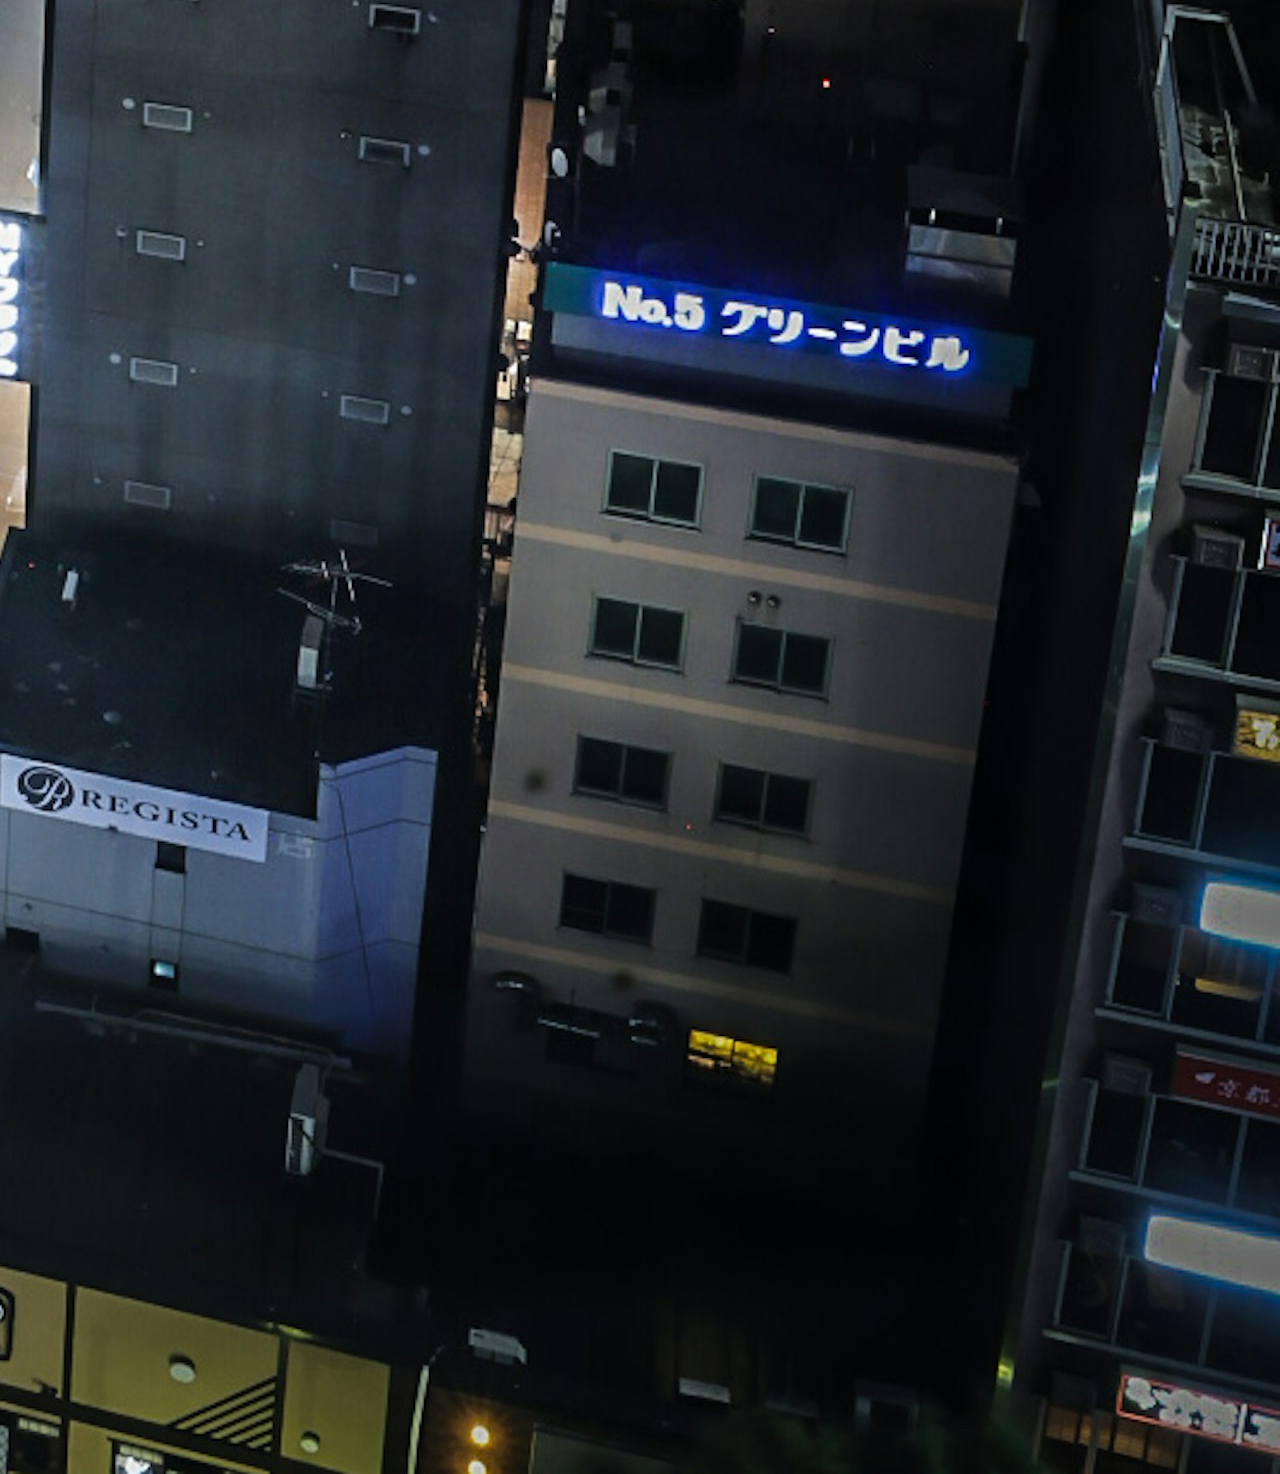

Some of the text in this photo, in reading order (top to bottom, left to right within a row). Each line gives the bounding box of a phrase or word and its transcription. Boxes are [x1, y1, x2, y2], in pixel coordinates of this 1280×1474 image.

[601, 281, 971, 372] No.5 グリーンビル
[80, 788, 252, 842] REGISTA
